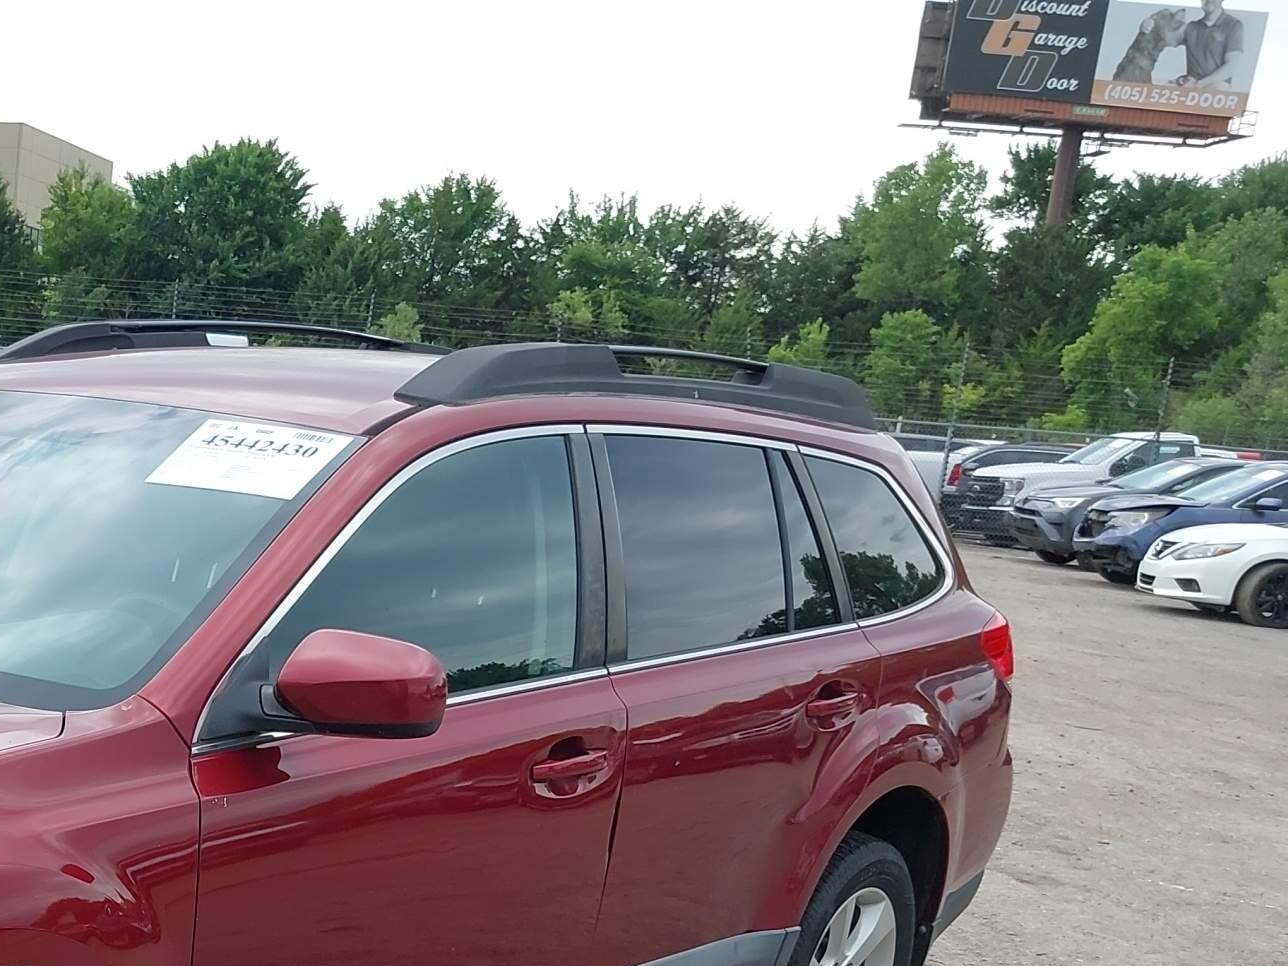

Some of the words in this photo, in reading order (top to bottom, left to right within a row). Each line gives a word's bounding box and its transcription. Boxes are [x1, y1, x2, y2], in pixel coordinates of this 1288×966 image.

[981, 13, 1089, 56] Garage
[996, 49, 1080, 93] Door
[1103, 83, 1147, 104] (405)
[1149, 88, 1239, 110] 525-DOOR
[202, 434, 319, 458] 45442430
